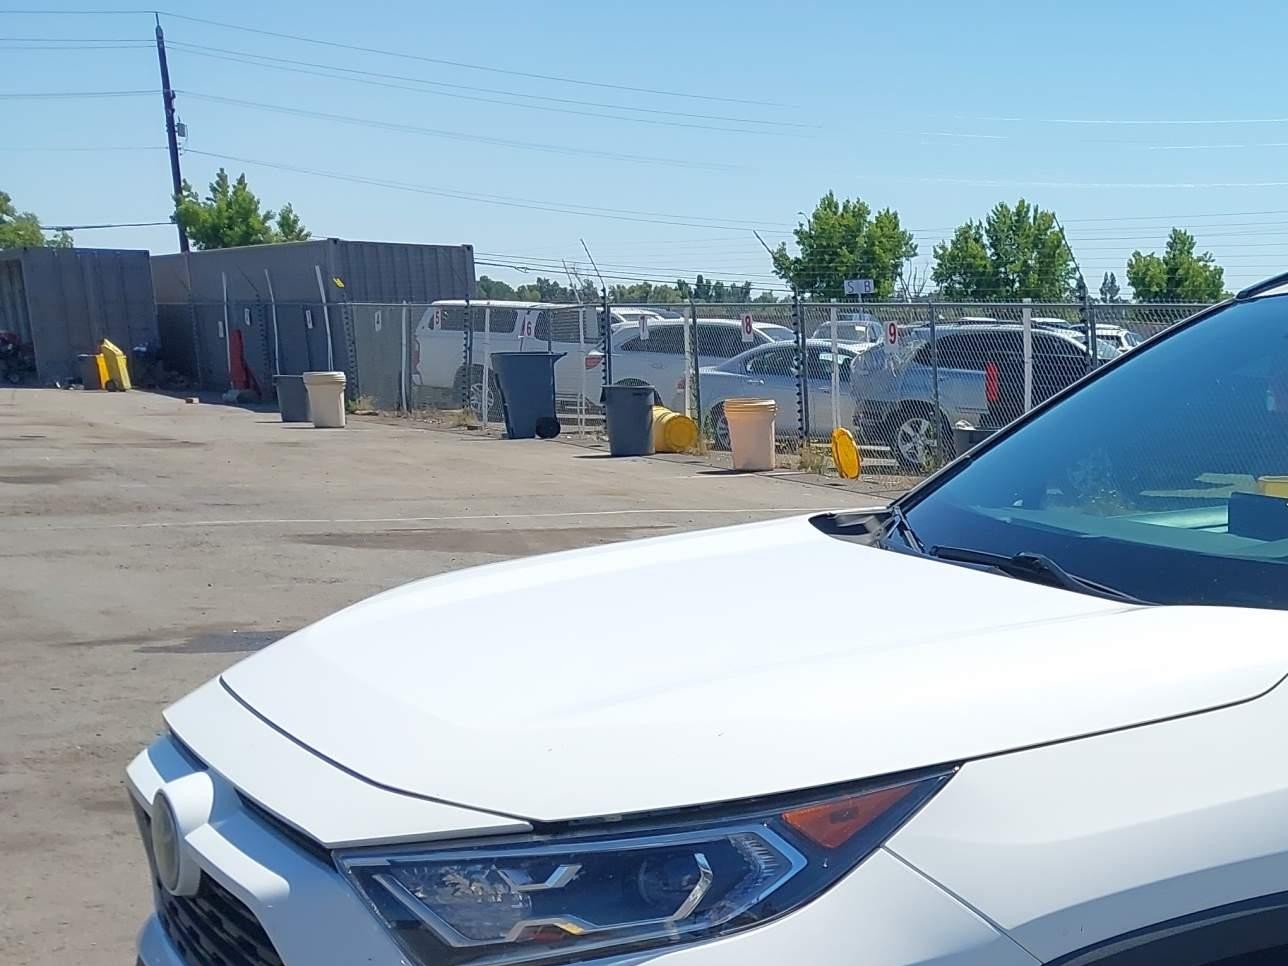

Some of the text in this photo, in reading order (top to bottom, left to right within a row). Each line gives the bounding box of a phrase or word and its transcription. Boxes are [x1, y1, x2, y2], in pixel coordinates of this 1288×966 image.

[526, 320, 532, 337] 6
[745, 315, 752, 335] 8
[888, 322, 896, 345] 9
